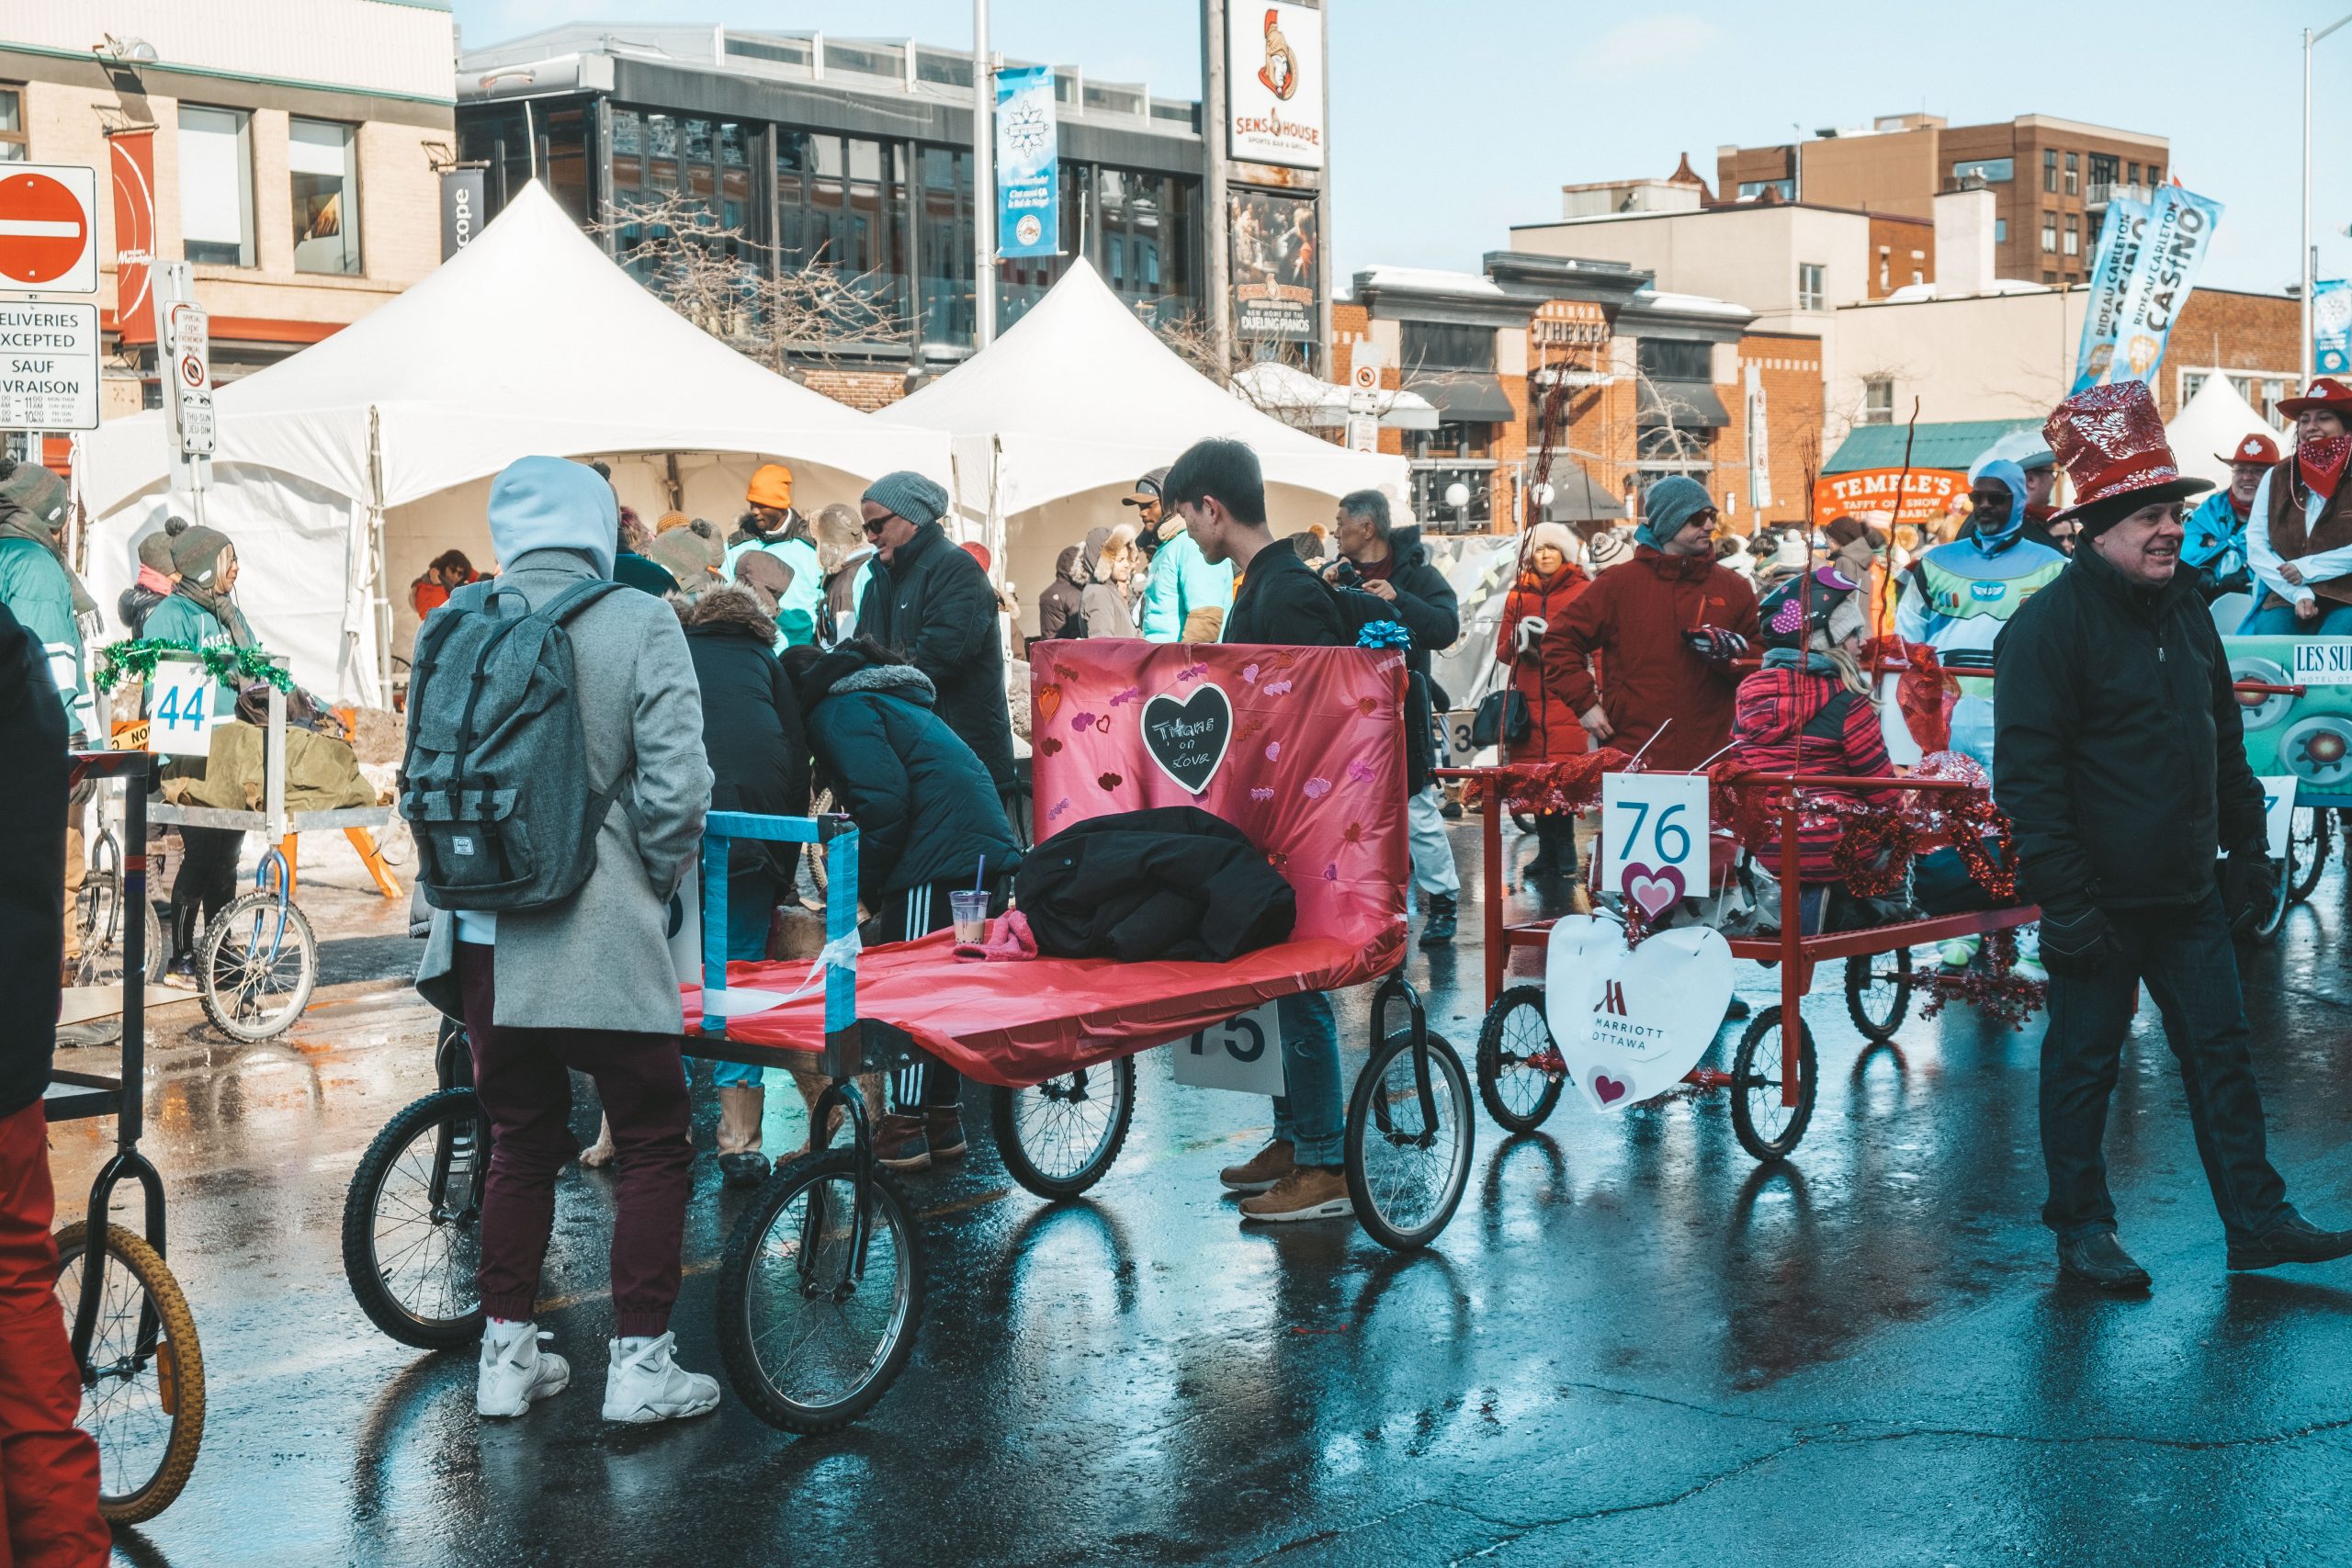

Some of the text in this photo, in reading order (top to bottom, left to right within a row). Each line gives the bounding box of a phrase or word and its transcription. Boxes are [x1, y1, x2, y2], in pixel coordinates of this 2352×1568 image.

[1237, 118, 1319, 145] SENS HOUSE
[456, 188, 472, 251] cope
[2096, 287, 2116, 338] RIDEAU
[2109, 213, 2132, 283] CARLETON
[2133, 276, 2156, 326] RIDEAU
[2151, 201, 2179, 274] CARLETON
[2146, 208, 2204, 333] CASINO
[1241, 316, 1310, 333] DUELING PIANOS
[12, 360, 55, 373] SAUF
[1833, 475, 1952, 499] TEMPLE'S
[1843, 500, 1877, 510] TAFFY
[1905, 498, 1940, 509] SNOW
[2297, 646, 2352, 671] LES SU
[157, 685, 206, 732] 44
[130, 725, 151, 745] NO
[1616, 801, 1691, 864] 76
[1591, 1032, 1646, 1050] OTTAWA
[1596, 1018, 1664, 1039] MARRIOTT
